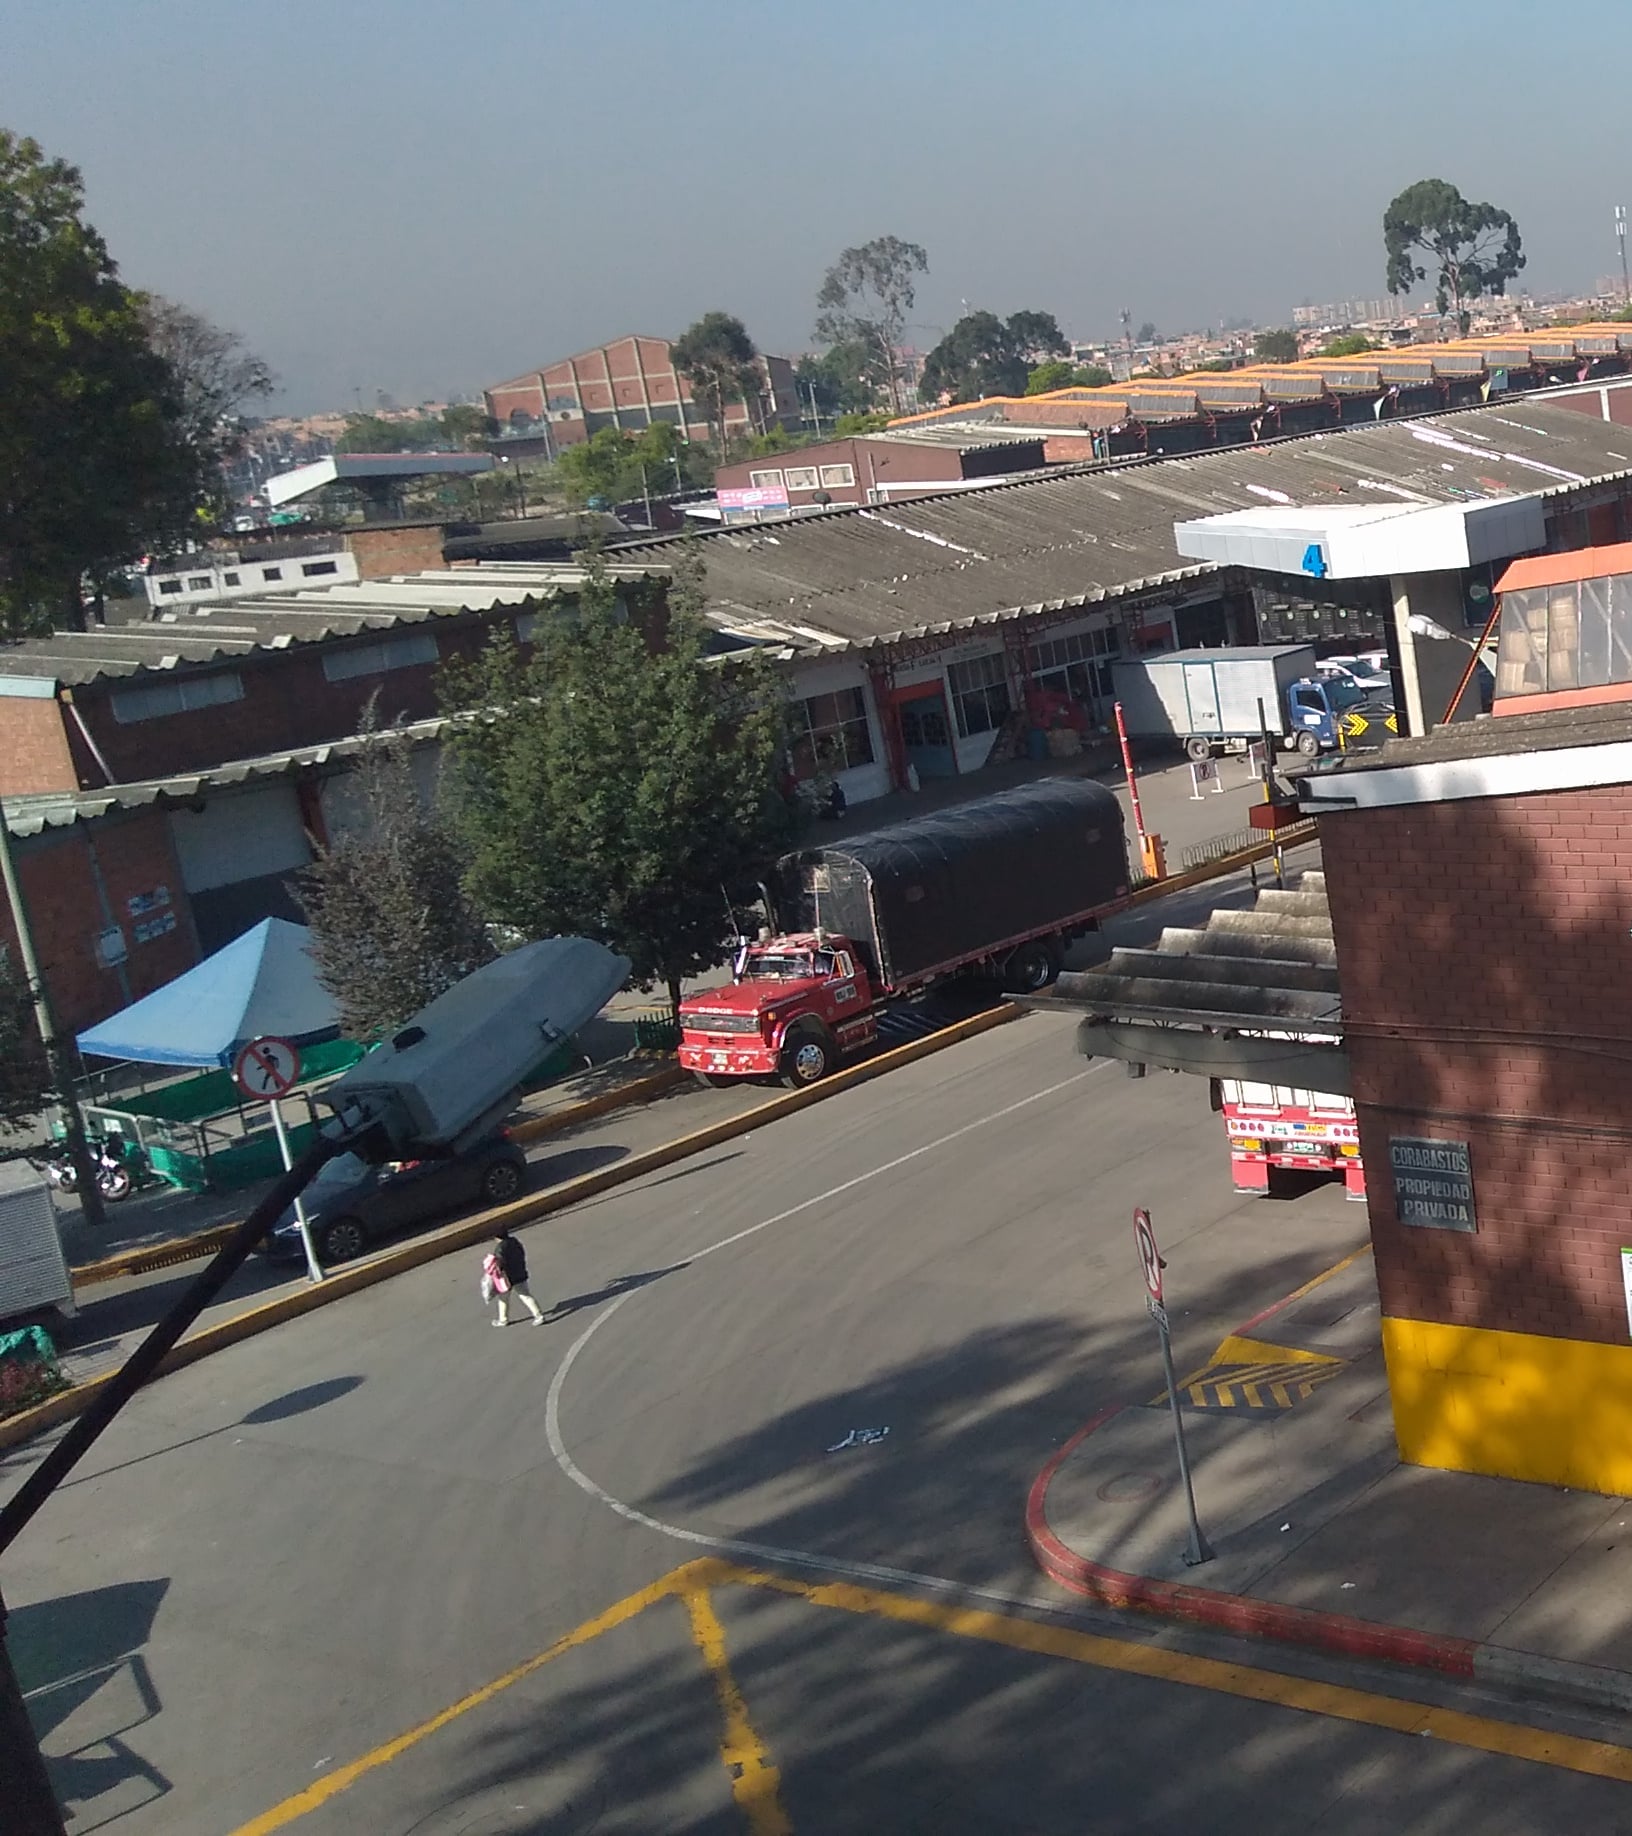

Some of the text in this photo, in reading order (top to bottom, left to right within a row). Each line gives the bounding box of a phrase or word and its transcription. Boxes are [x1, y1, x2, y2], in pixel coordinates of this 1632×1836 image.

[1302, 544, 1328, 579] 4
[698, 1006, 734, 1014] DODGE
[1392, 1146, 1468, 1171] CORABASTOS
[1396, 1177, 1470, 1200] PROPIEDAD
[1404, 1200, 1468, 1221] PRIVADA
